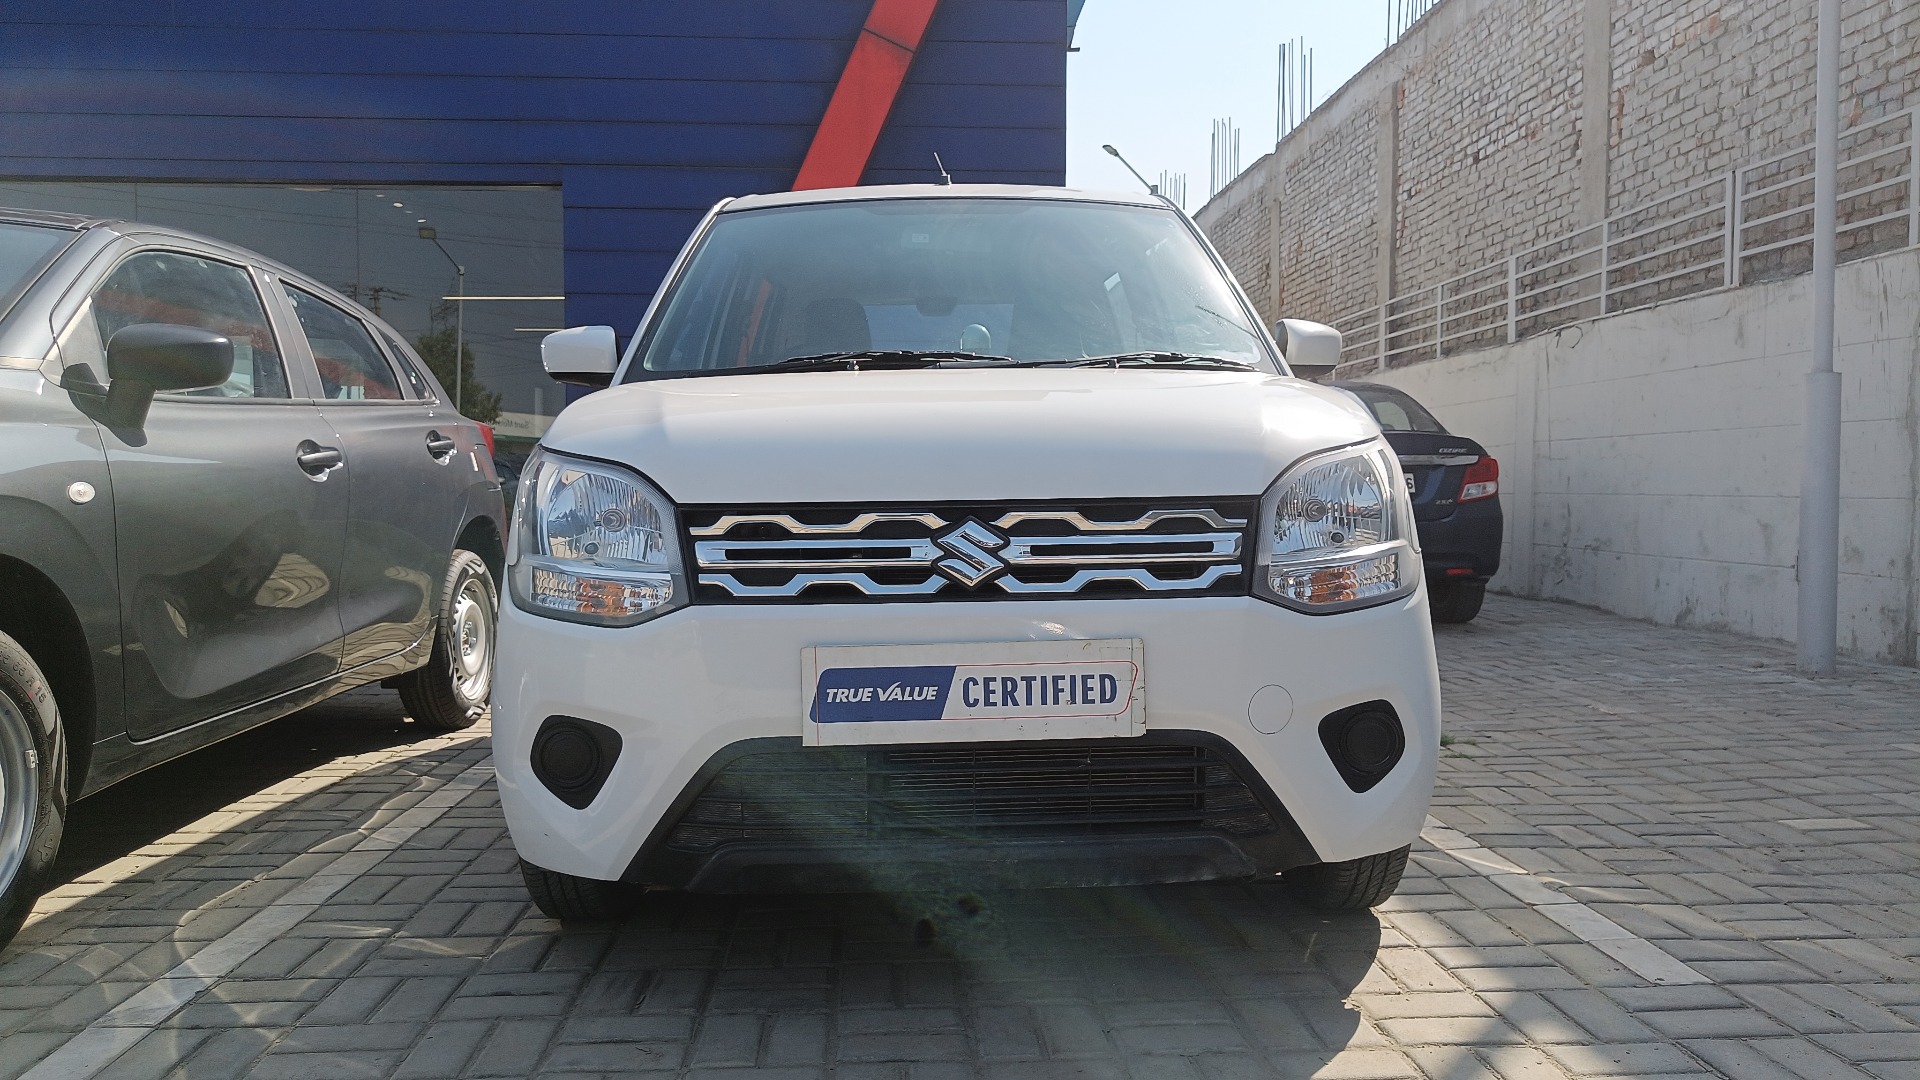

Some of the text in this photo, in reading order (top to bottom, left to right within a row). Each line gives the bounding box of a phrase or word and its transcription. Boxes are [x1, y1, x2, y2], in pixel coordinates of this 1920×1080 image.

[826, 672, 1118, 708] TRUE VALUE CERTIFIED
